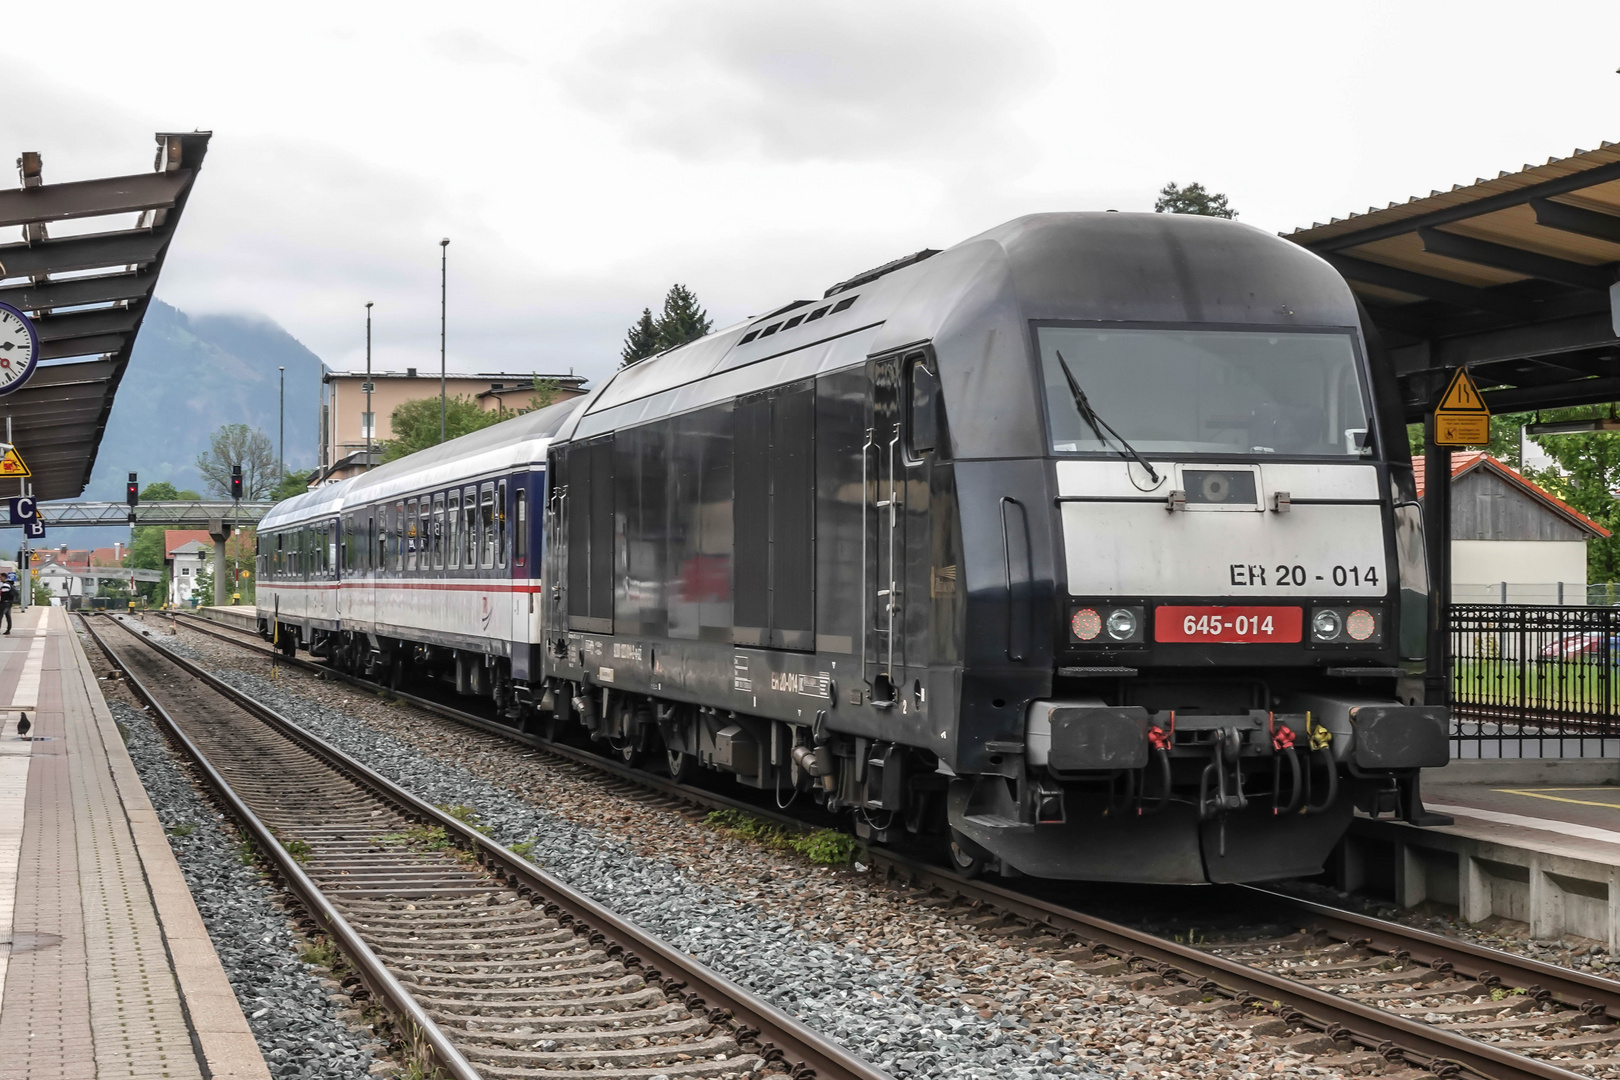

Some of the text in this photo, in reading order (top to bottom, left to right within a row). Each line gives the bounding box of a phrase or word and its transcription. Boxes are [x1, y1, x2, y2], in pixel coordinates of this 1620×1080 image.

[17, 498, 33, 519] C
[32, 520, 44, 535] B
[1230, 564, 1267, 586] ER
[1275, 564, 1307, 586] 20
[1332, 565, 1379, 587] 014
[1183, 615, 1275, 636] 645-014
[902, 699, 907, 715] 2
